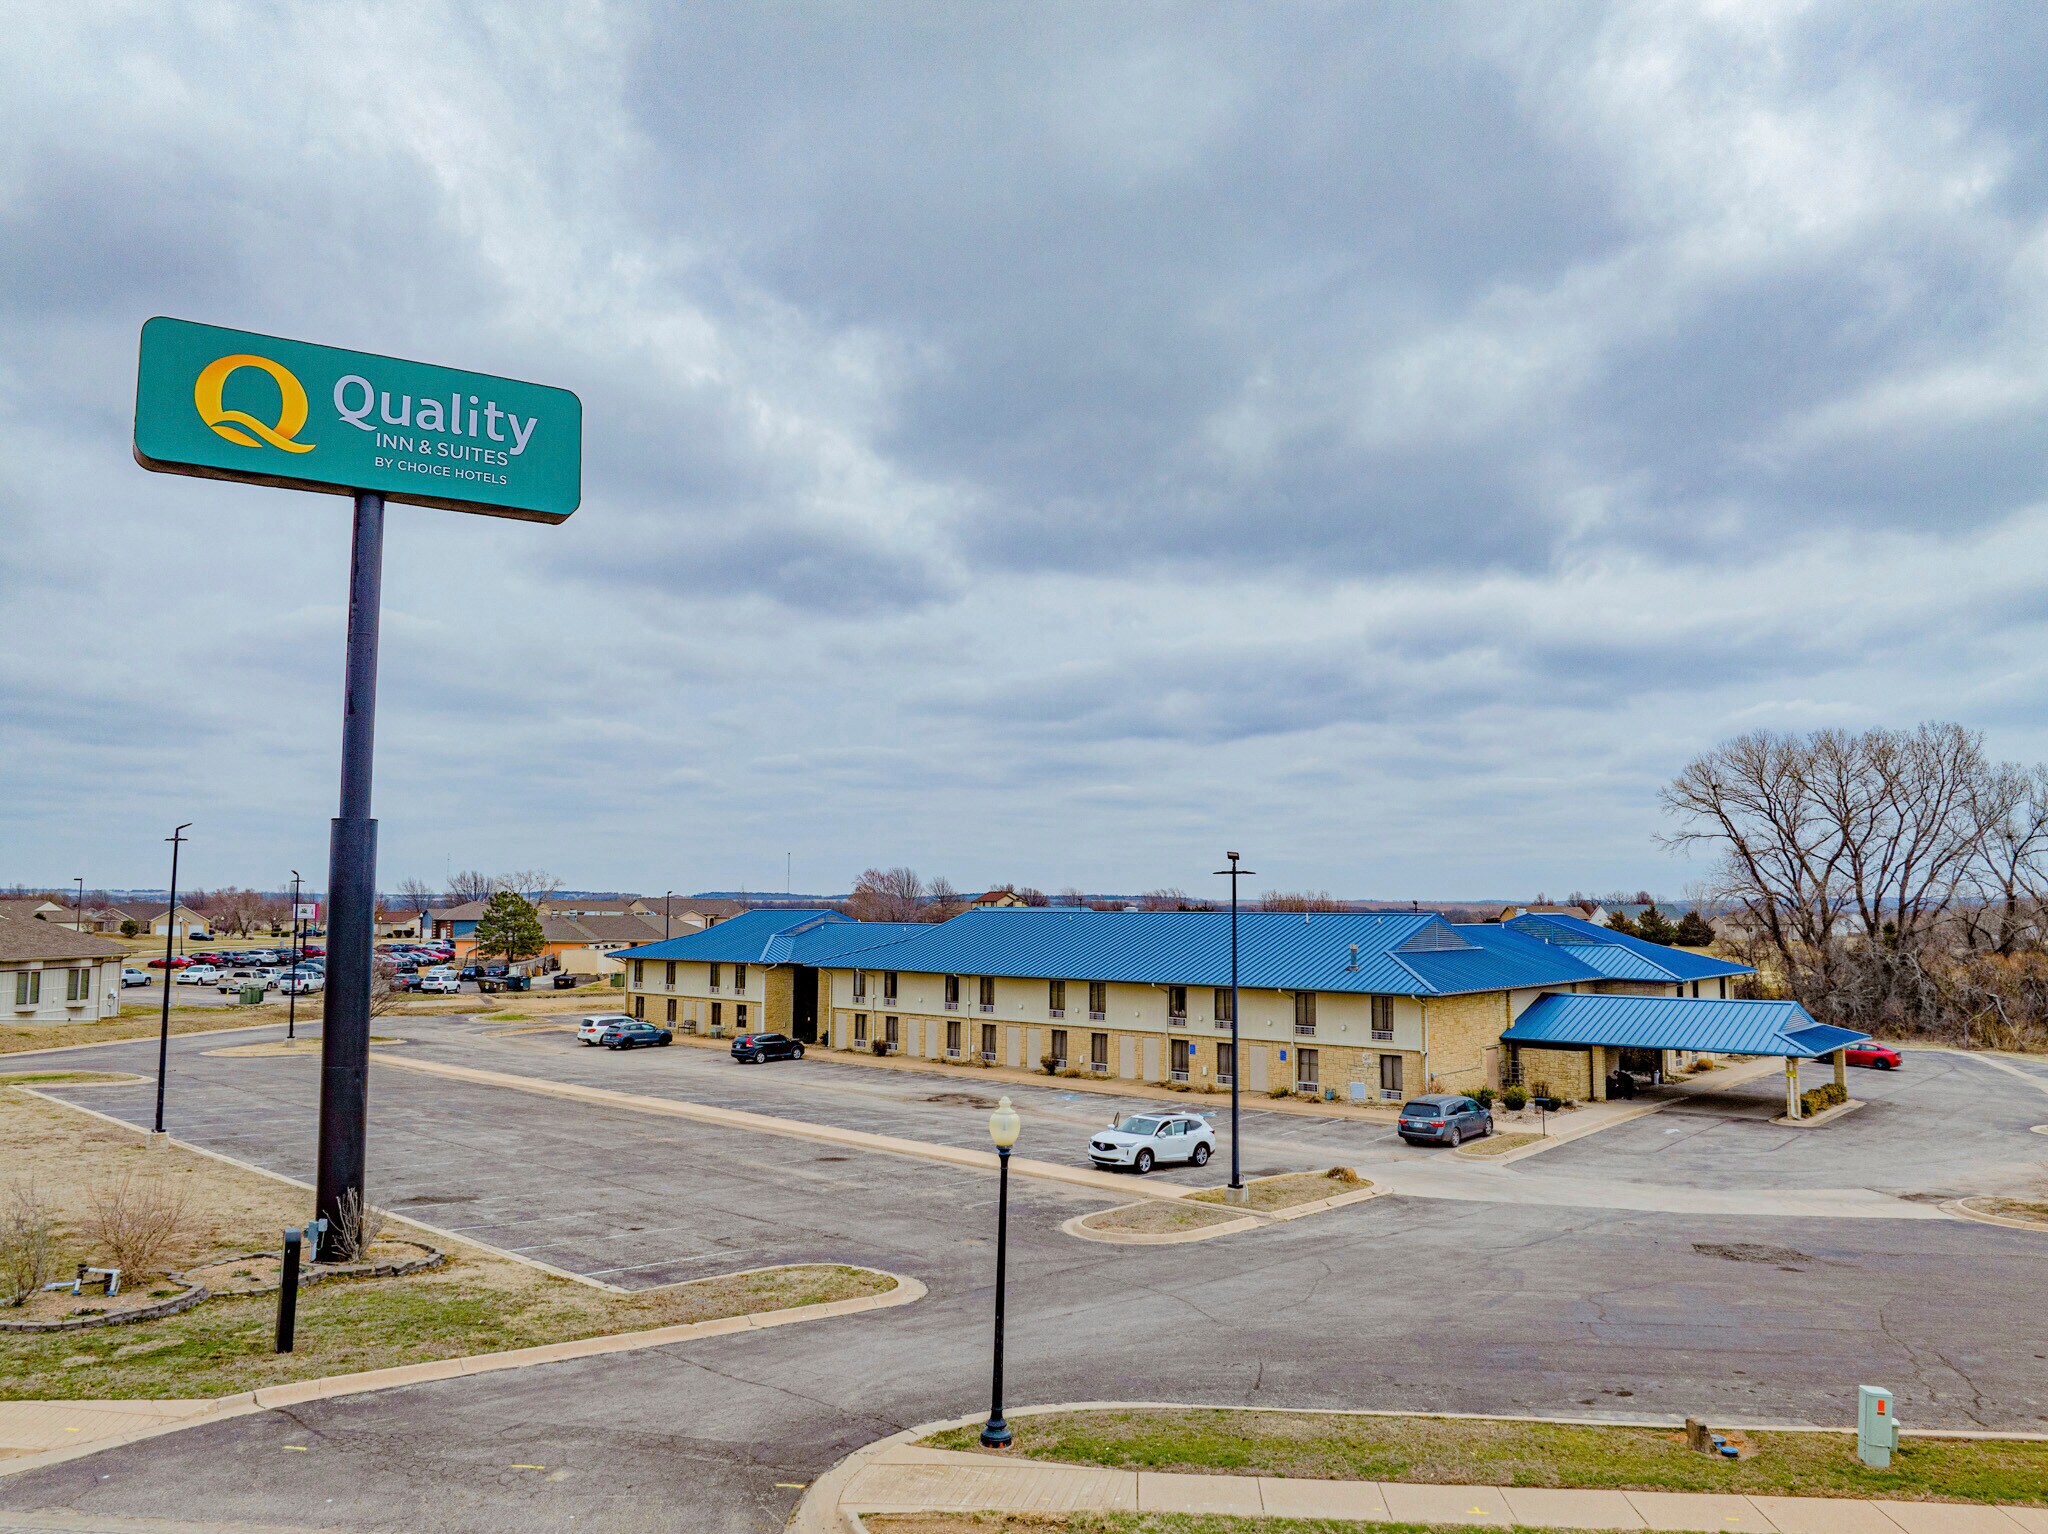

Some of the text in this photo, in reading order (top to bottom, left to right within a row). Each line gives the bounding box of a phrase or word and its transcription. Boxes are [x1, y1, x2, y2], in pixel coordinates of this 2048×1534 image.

[194, 353, 317, 454] Q
[333, 374, 538, 456] Quality
[374, 456, 507, 485] BY CHOICE HOTELS
[376, 432, 508, 466] INN & SUITES
